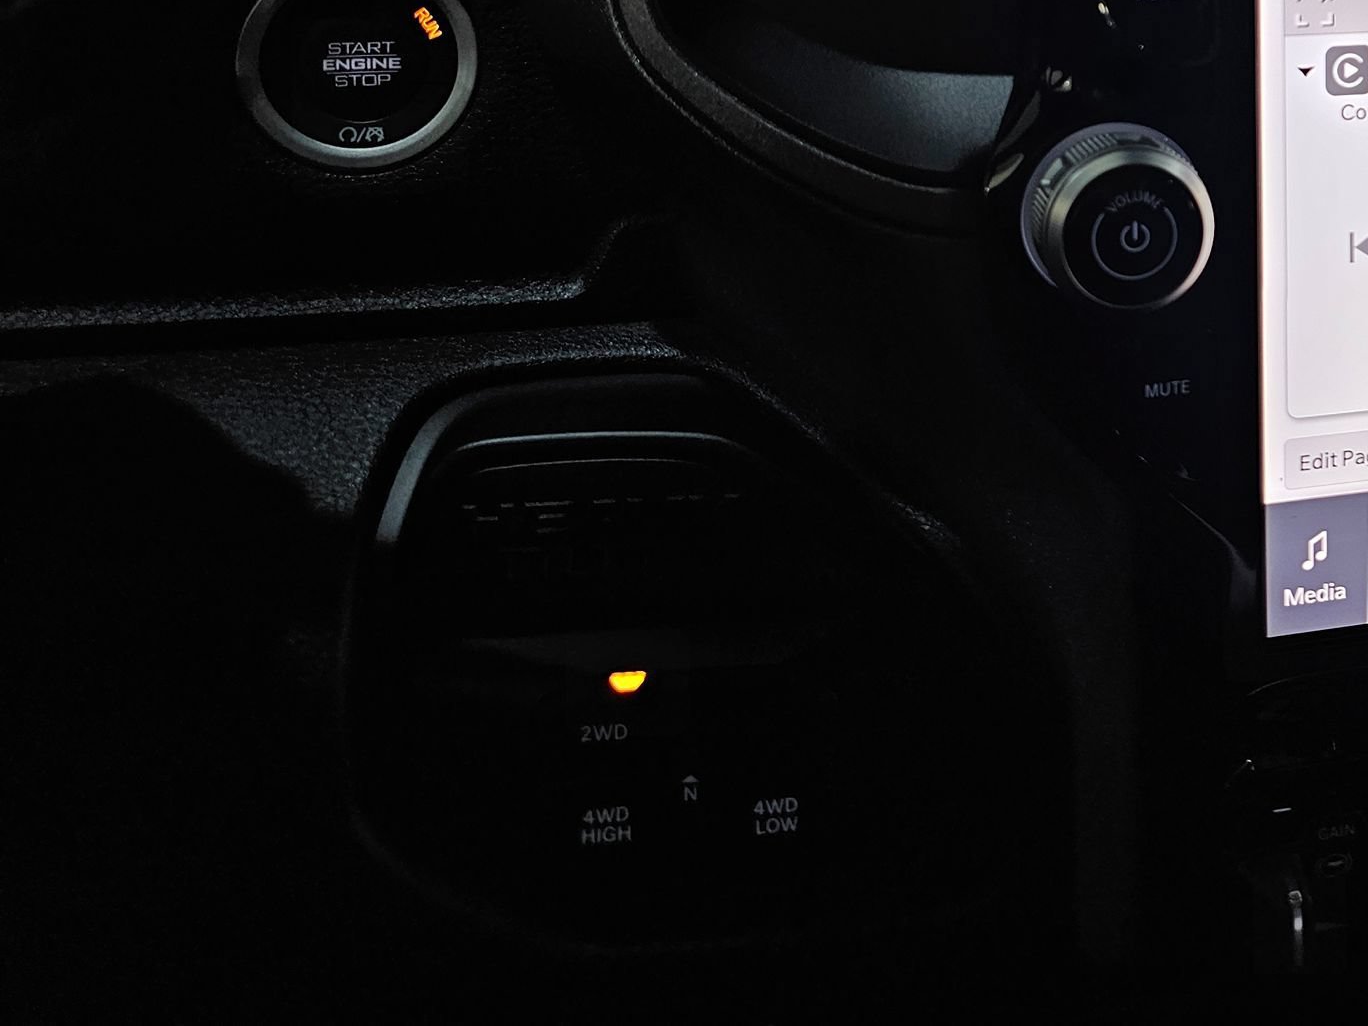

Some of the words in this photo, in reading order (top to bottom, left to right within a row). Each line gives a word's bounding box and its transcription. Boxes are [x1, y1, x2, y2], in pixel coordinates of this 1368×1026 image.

[413, 6, 443, 41] RUN
[328, 41, 395, 55] START
[322, 56, 402, 72] ENGINE
[334, 73, 391, 87] STOP
[1104, 189, 1165, 214] VOLUME
[1144, 379, 1191, 399] MUTE
[1300, 451, 1337, 472] Edit
[1283, 581, 1347, 607] Media
[581, 723, 628, 742] 2WD
[684, 786, 698, 801] N
[583, 805, 630, 824] 4WD
[753, 797, 799, 816] 4WD
[581, 824, 632, 844] HIGH
[755, 816, 799, 836] LOW
